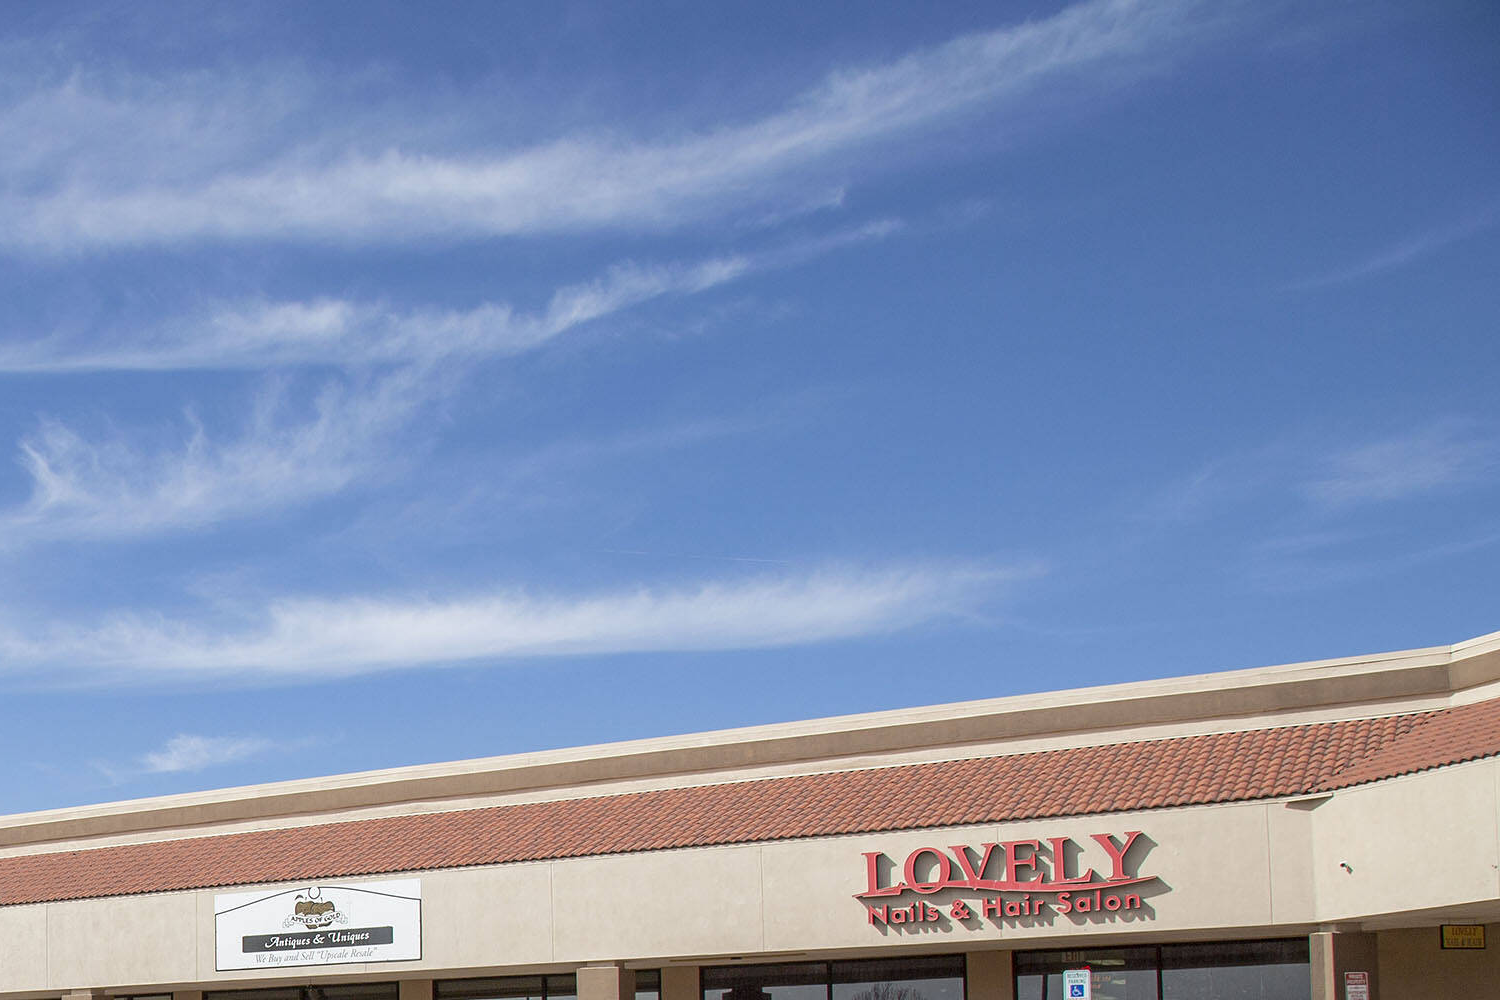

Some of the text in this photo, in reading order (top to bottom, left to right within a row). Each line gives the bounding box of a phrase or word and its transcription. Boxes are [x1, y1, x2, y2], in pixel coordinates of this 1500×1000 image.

[861, 831, 1143, 897] LOVELY
[867, 891, 1141, 925] Nails & Hair Salon
[290, 912, 342, 924] APPLES OF GOLD
[264, 931, 370, 949] Antiques & Uniques
[254, 954, 267, 963] We
[268, 953, 282, 965] Buy
[284, 952, 298, 962] and
[300, 950, 315, 961] Sell
